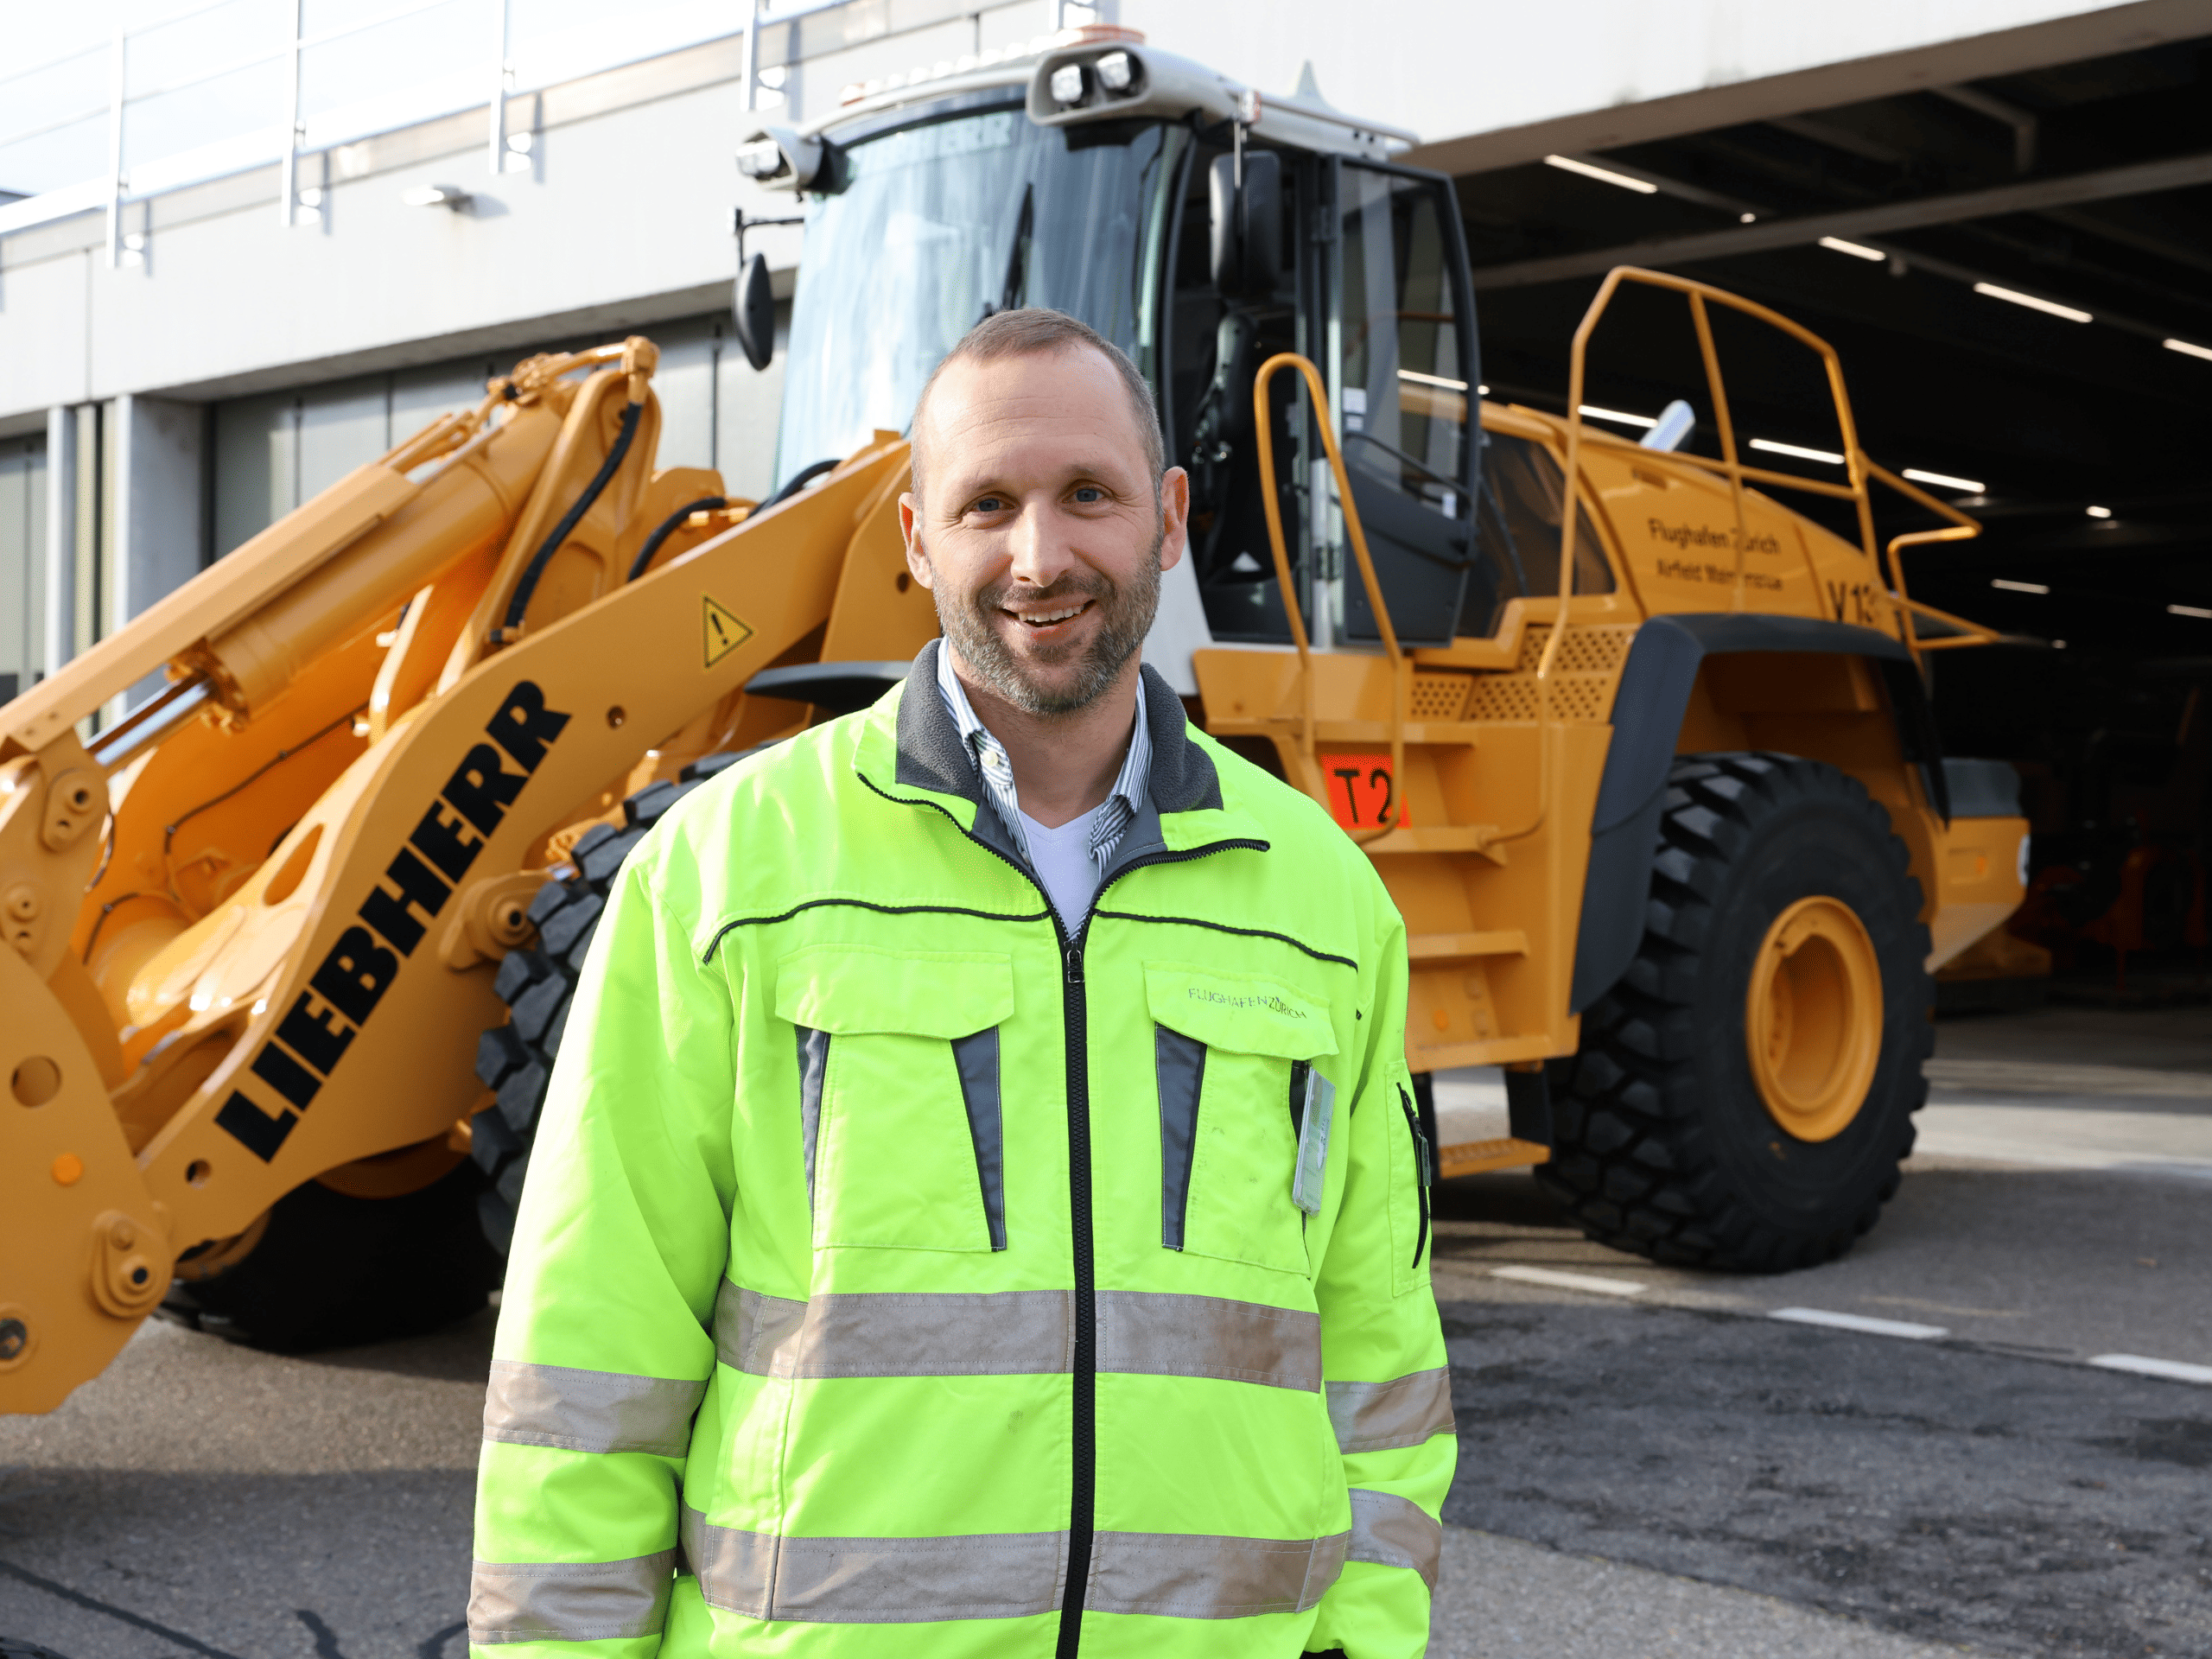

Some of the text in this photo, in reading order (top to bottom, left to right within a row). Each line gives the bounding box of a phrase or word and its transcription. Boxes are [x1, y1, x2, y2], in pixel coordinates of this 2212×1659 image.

[1648, 518, 1729, 550] Flughafen
[1333, 768, 1393, 824] T2
[213, 681, 572, 1163] LIEBHERR
